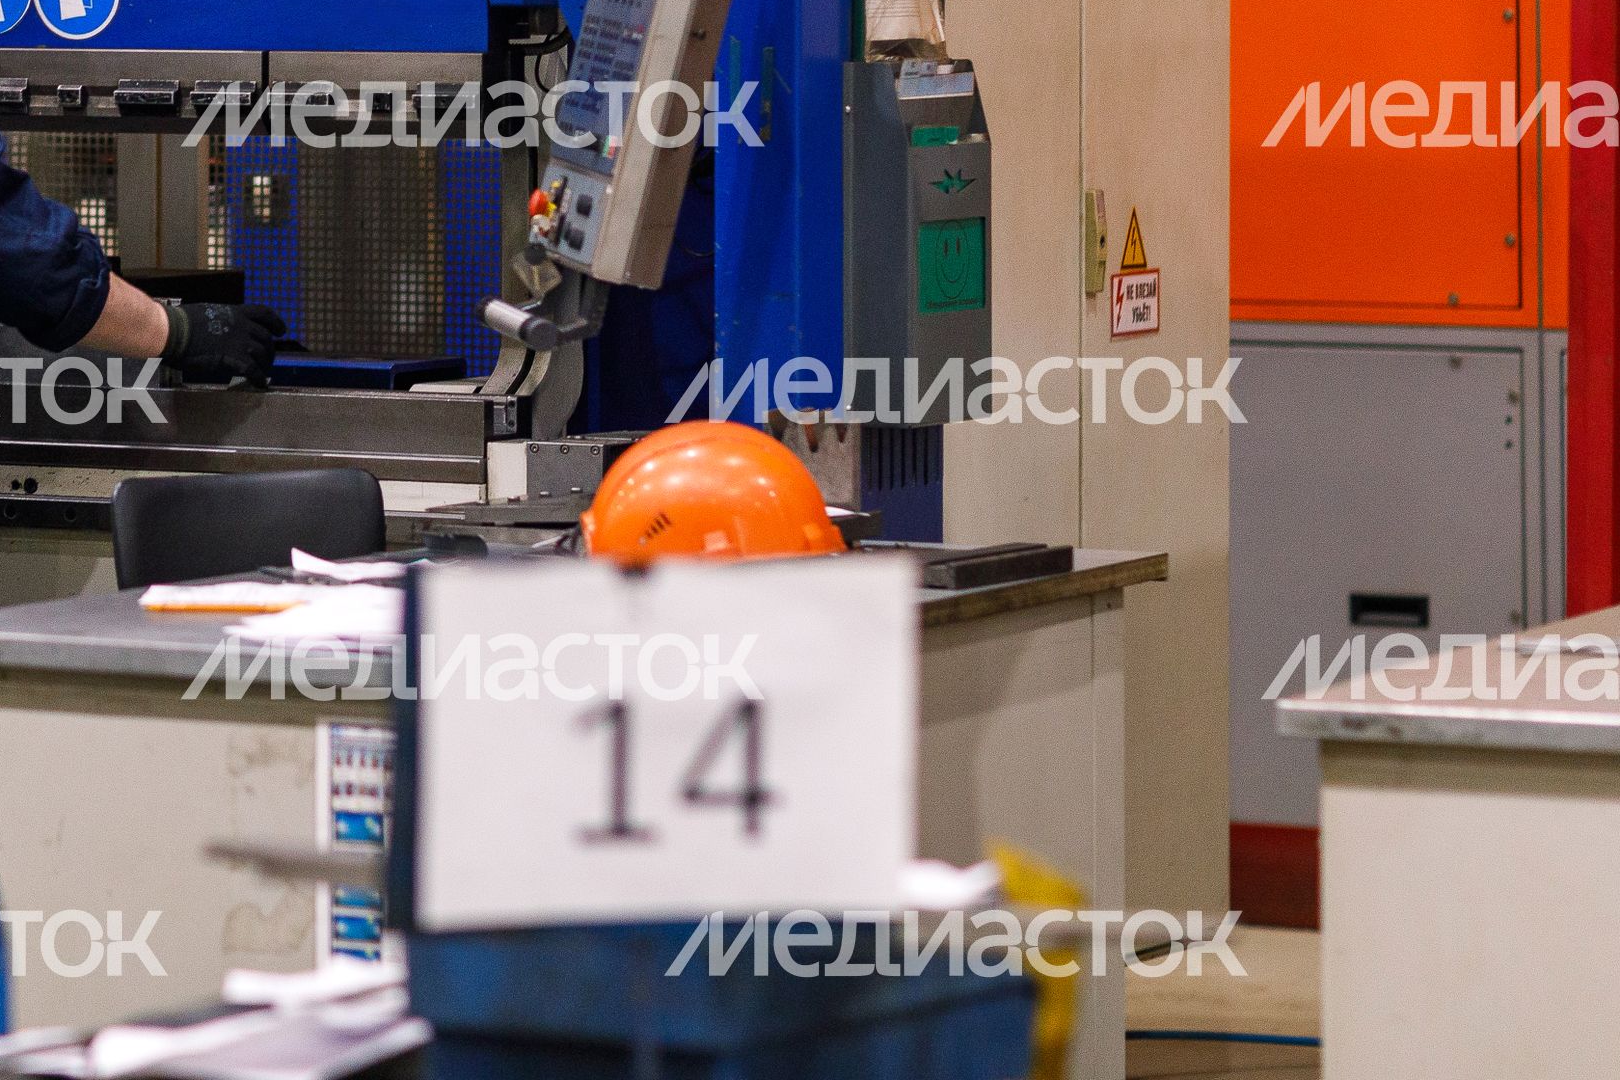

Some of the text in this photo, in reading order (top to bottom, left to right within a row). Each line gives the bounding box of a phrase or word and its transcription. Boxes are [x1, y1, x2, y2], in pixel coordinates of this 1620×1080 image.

[1126, 278, 1157, 300] НЕ ВЛЕЗАЙ
[572, 698, 782, 846] 14
